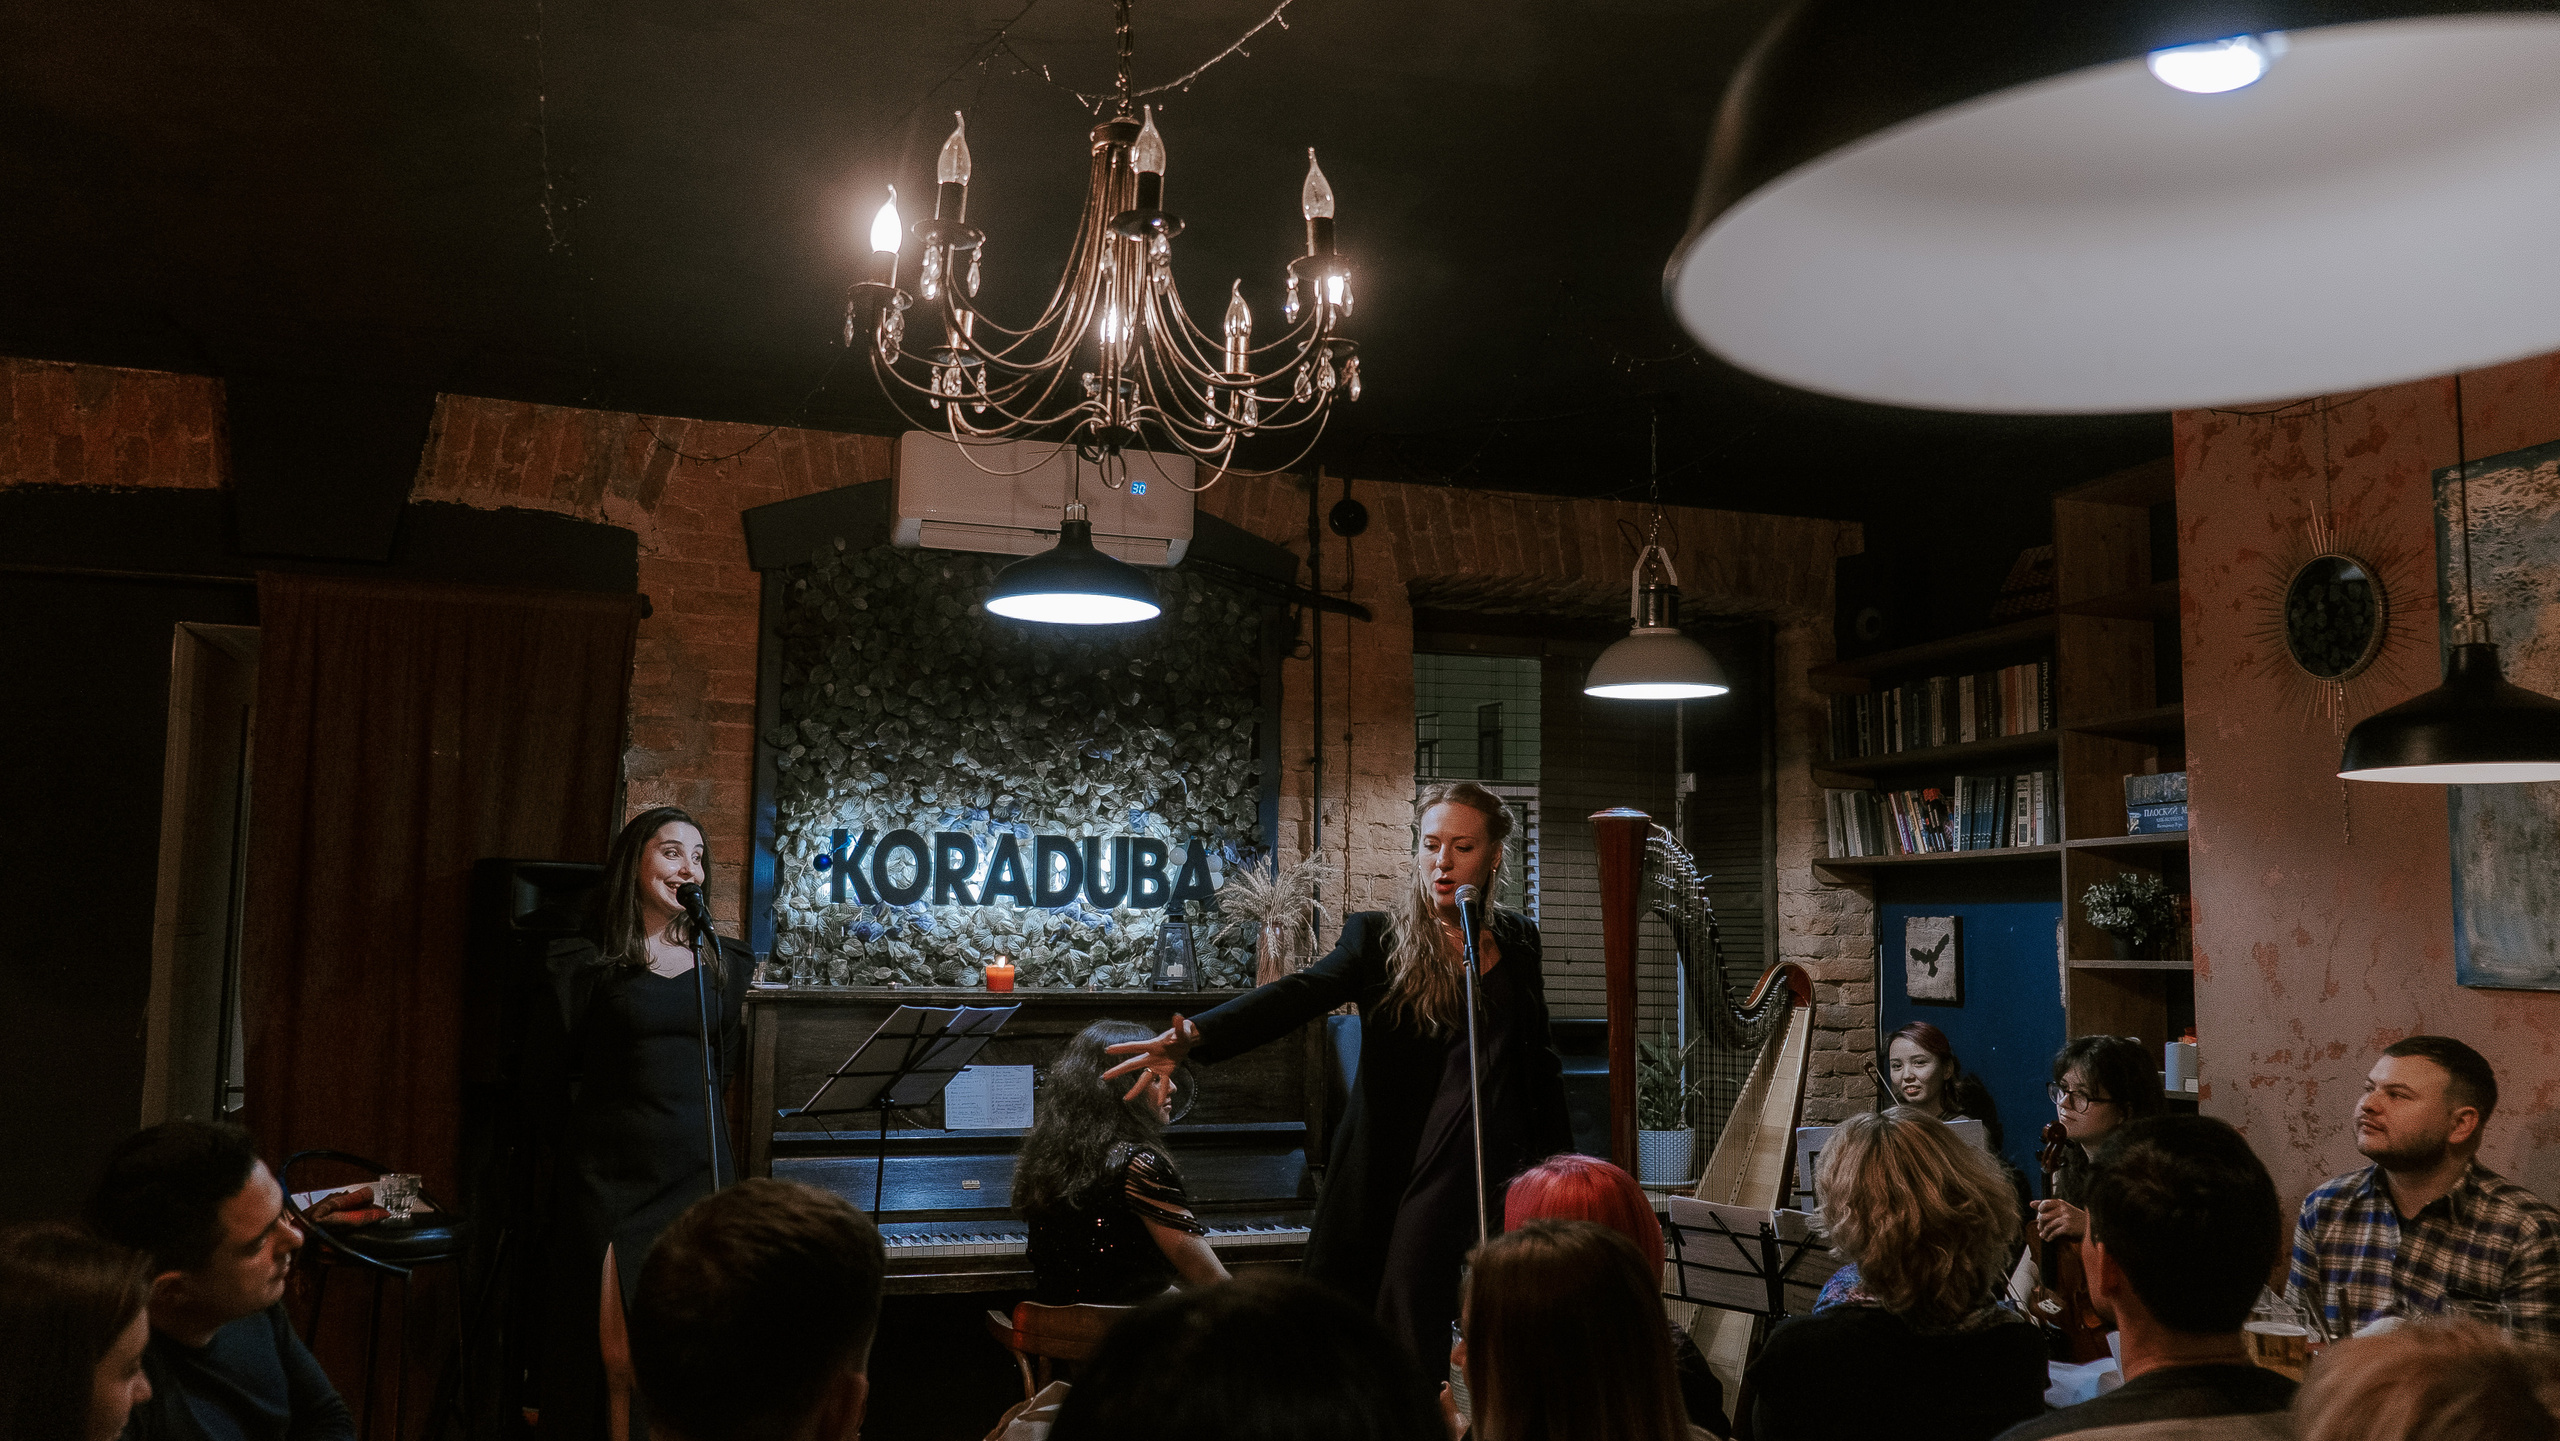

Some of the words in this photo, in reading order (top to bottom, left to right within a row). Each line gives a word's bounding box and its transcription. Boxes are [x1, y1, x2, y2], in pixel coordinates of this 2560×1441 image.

[1132, 484, 1146, 495] 30
[2143, 806, 2178, 817] ПЛОСКИЙ
[831, 829, 1215, 909] KORADUBA
